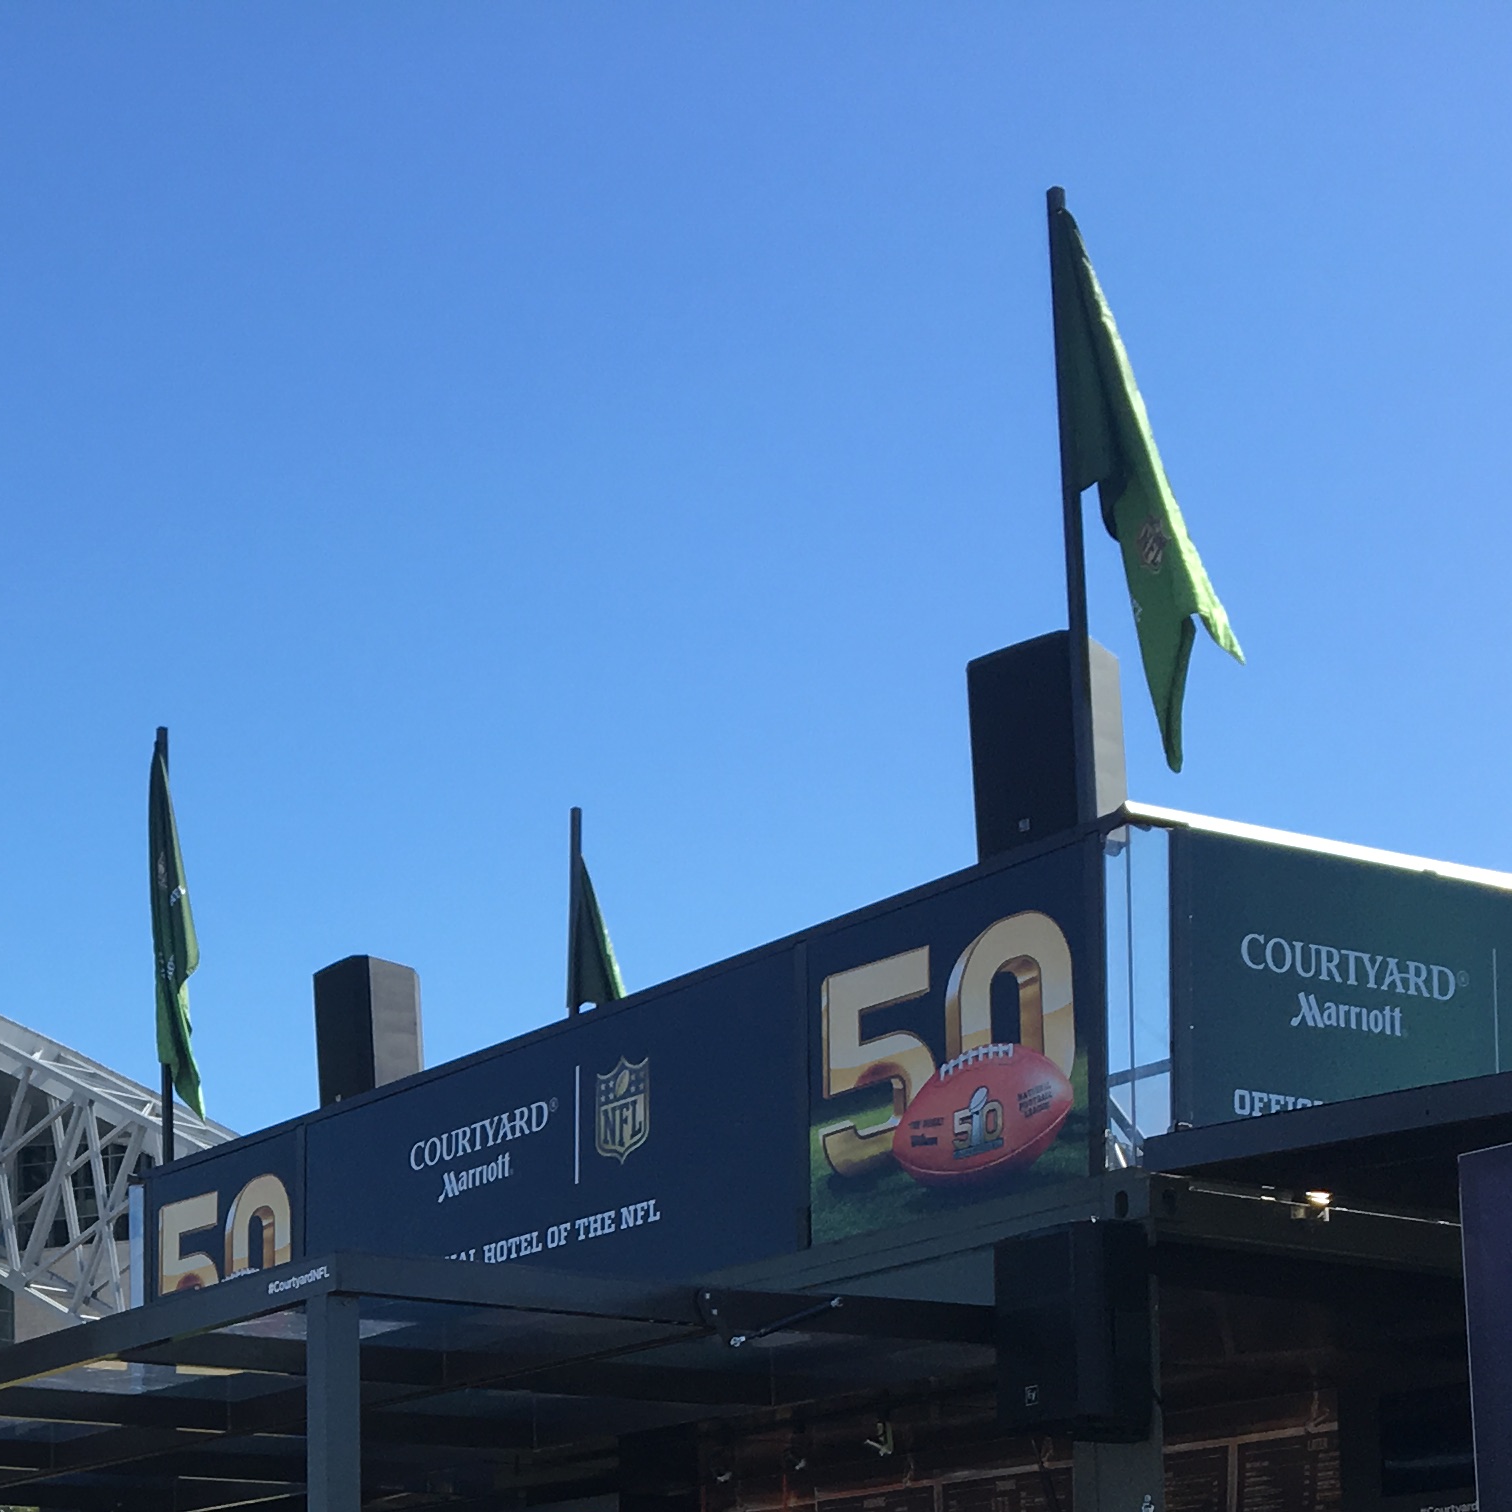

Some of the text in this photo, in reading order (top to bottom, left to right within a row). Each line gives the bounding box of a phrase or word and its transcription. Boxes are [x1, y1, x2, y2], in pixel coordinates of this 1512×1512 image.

[1241, 933, 1456, 1001] COURTYARD
[1290, 991, 1402, 1036] Marriott
[818, 909, 1076, 1177] 50
[409, 1100, 548, 1171] COURTYARD
[600, 1099, 645, 1149] NFL
[952, 1099, 1004, 1150] 50
[438, 1152, 511, 1203] Marriott
[483, 1231, 542, 1264] HOTEL
[547, 1222, 571, 1248] OF
[575, 1210, 616, 1241] THE
[620, 1199, 661, 1230] NFL
[268, 1265, 330, 1294] #CourtyardNFL
